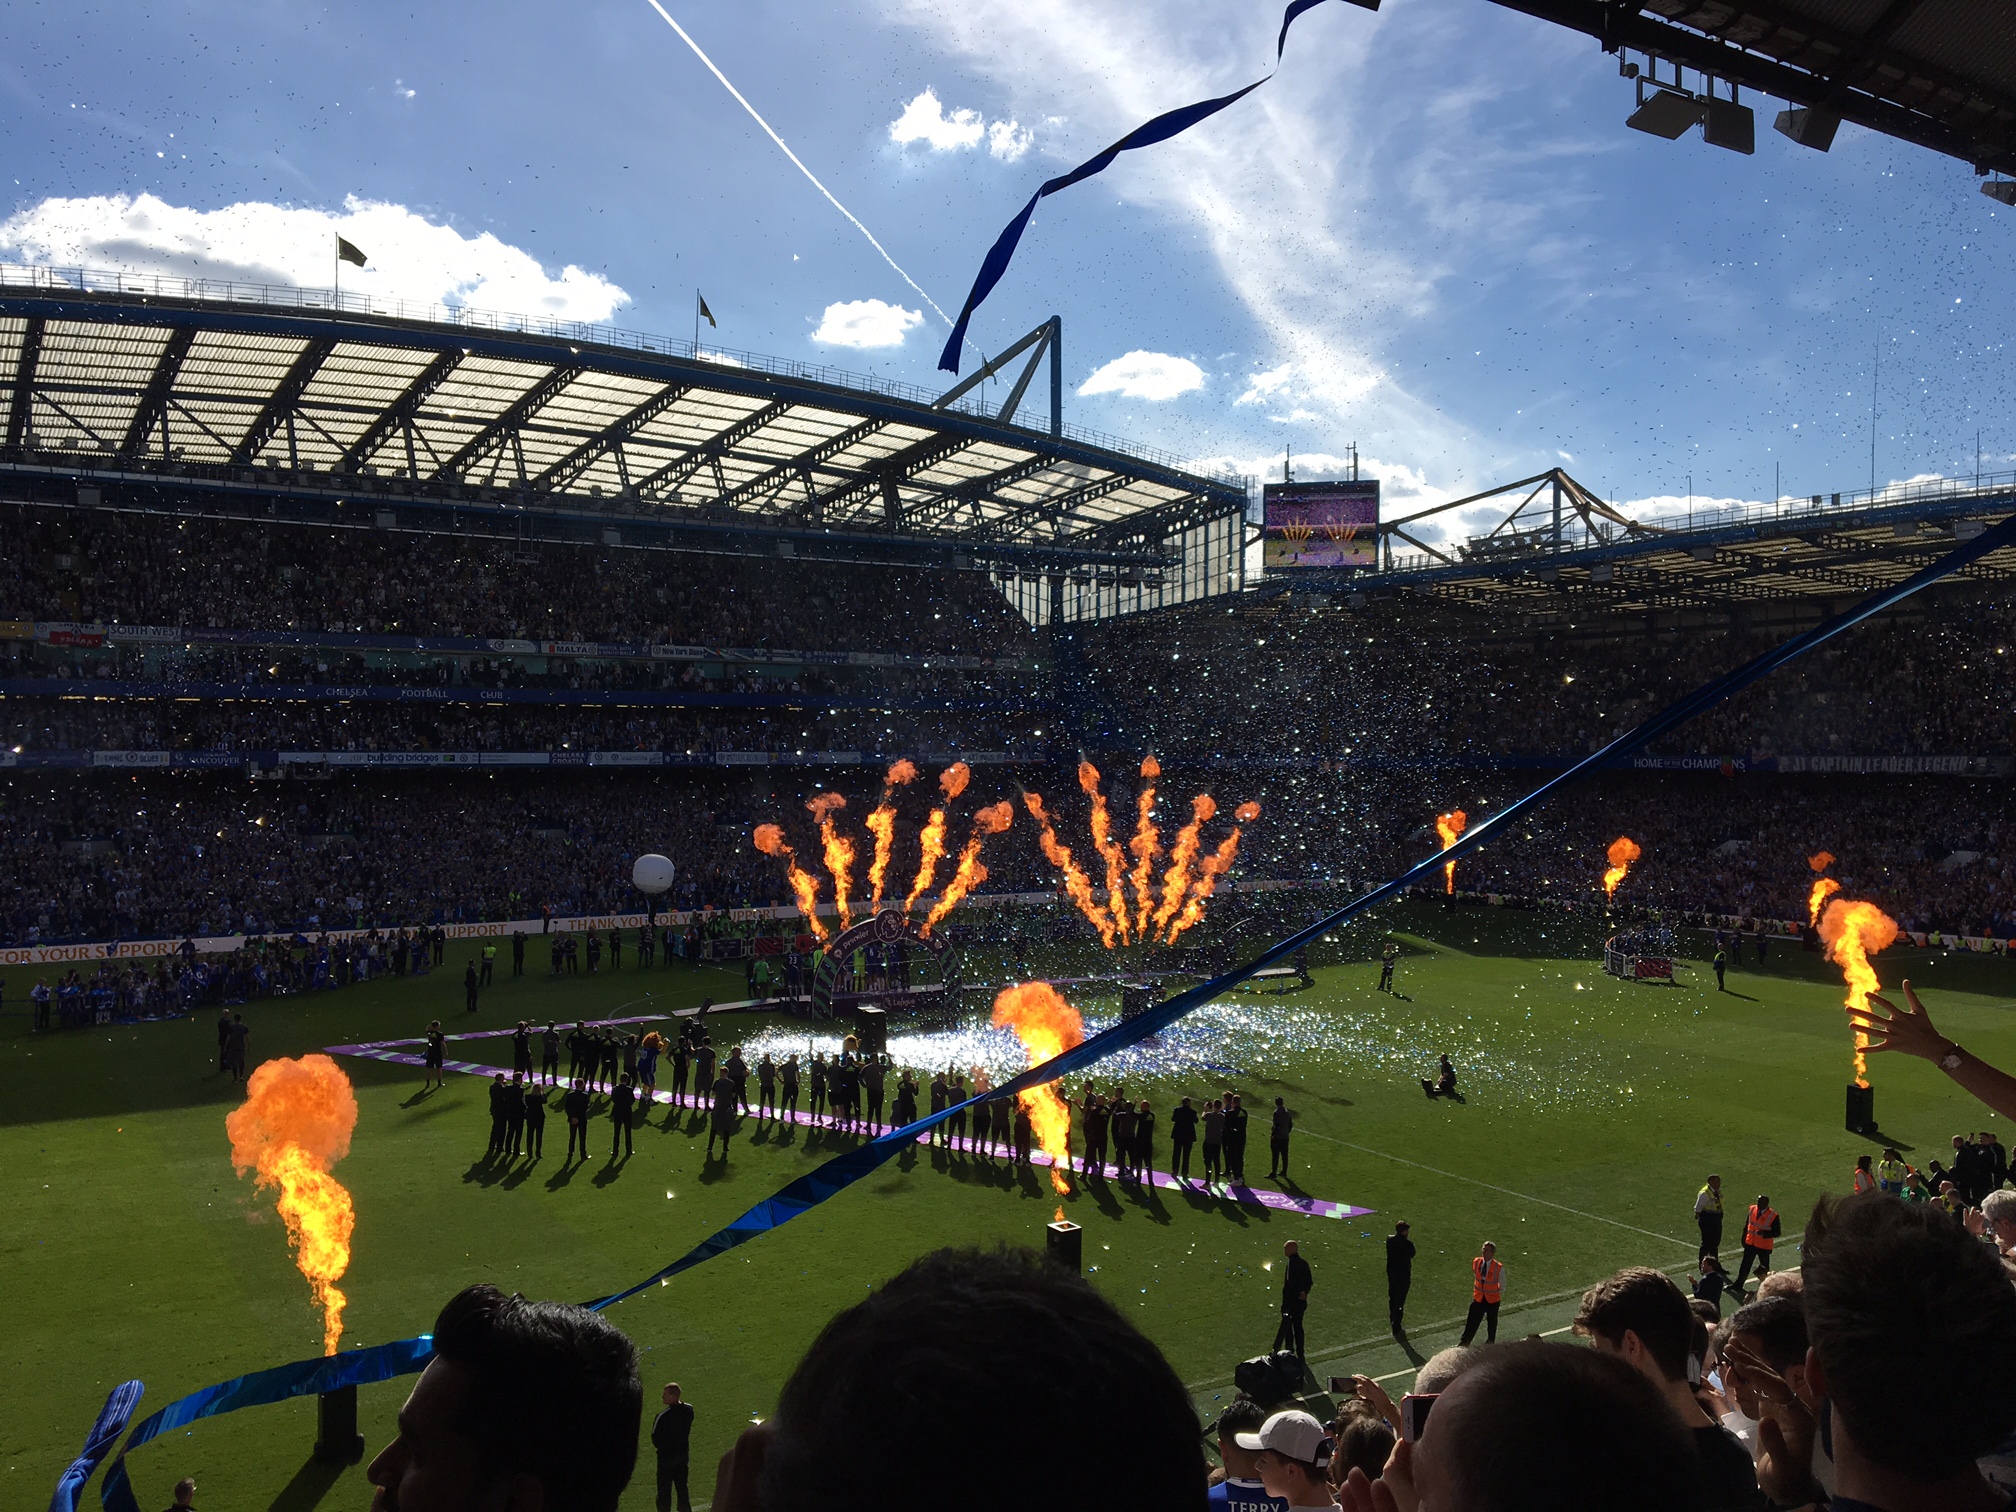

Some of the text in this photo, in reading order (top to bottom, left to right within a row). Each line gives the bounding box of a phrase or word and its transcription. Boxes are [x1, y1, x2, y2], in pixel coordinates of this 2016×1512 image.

[110, 626, 180, 636] SOUTH WEST
[325, 687, 503, 699] CHELSEA FOOTBALL CLUB
[405, 753, 439, 763] bridges
[1634, 758, 1663, 768] HOME
[1682, 758, 1746, 769] CHAMPINS
[568, 918, 616, 931] THANK
[442, 923, 507, 938] UPPORT
[38, 947, 84, 962] YOUR
[95, 941, 180, 959] SUPPORT
[788, 956, 798, 965] 23
[1228, 1501, 1280, 1512] TERRY
